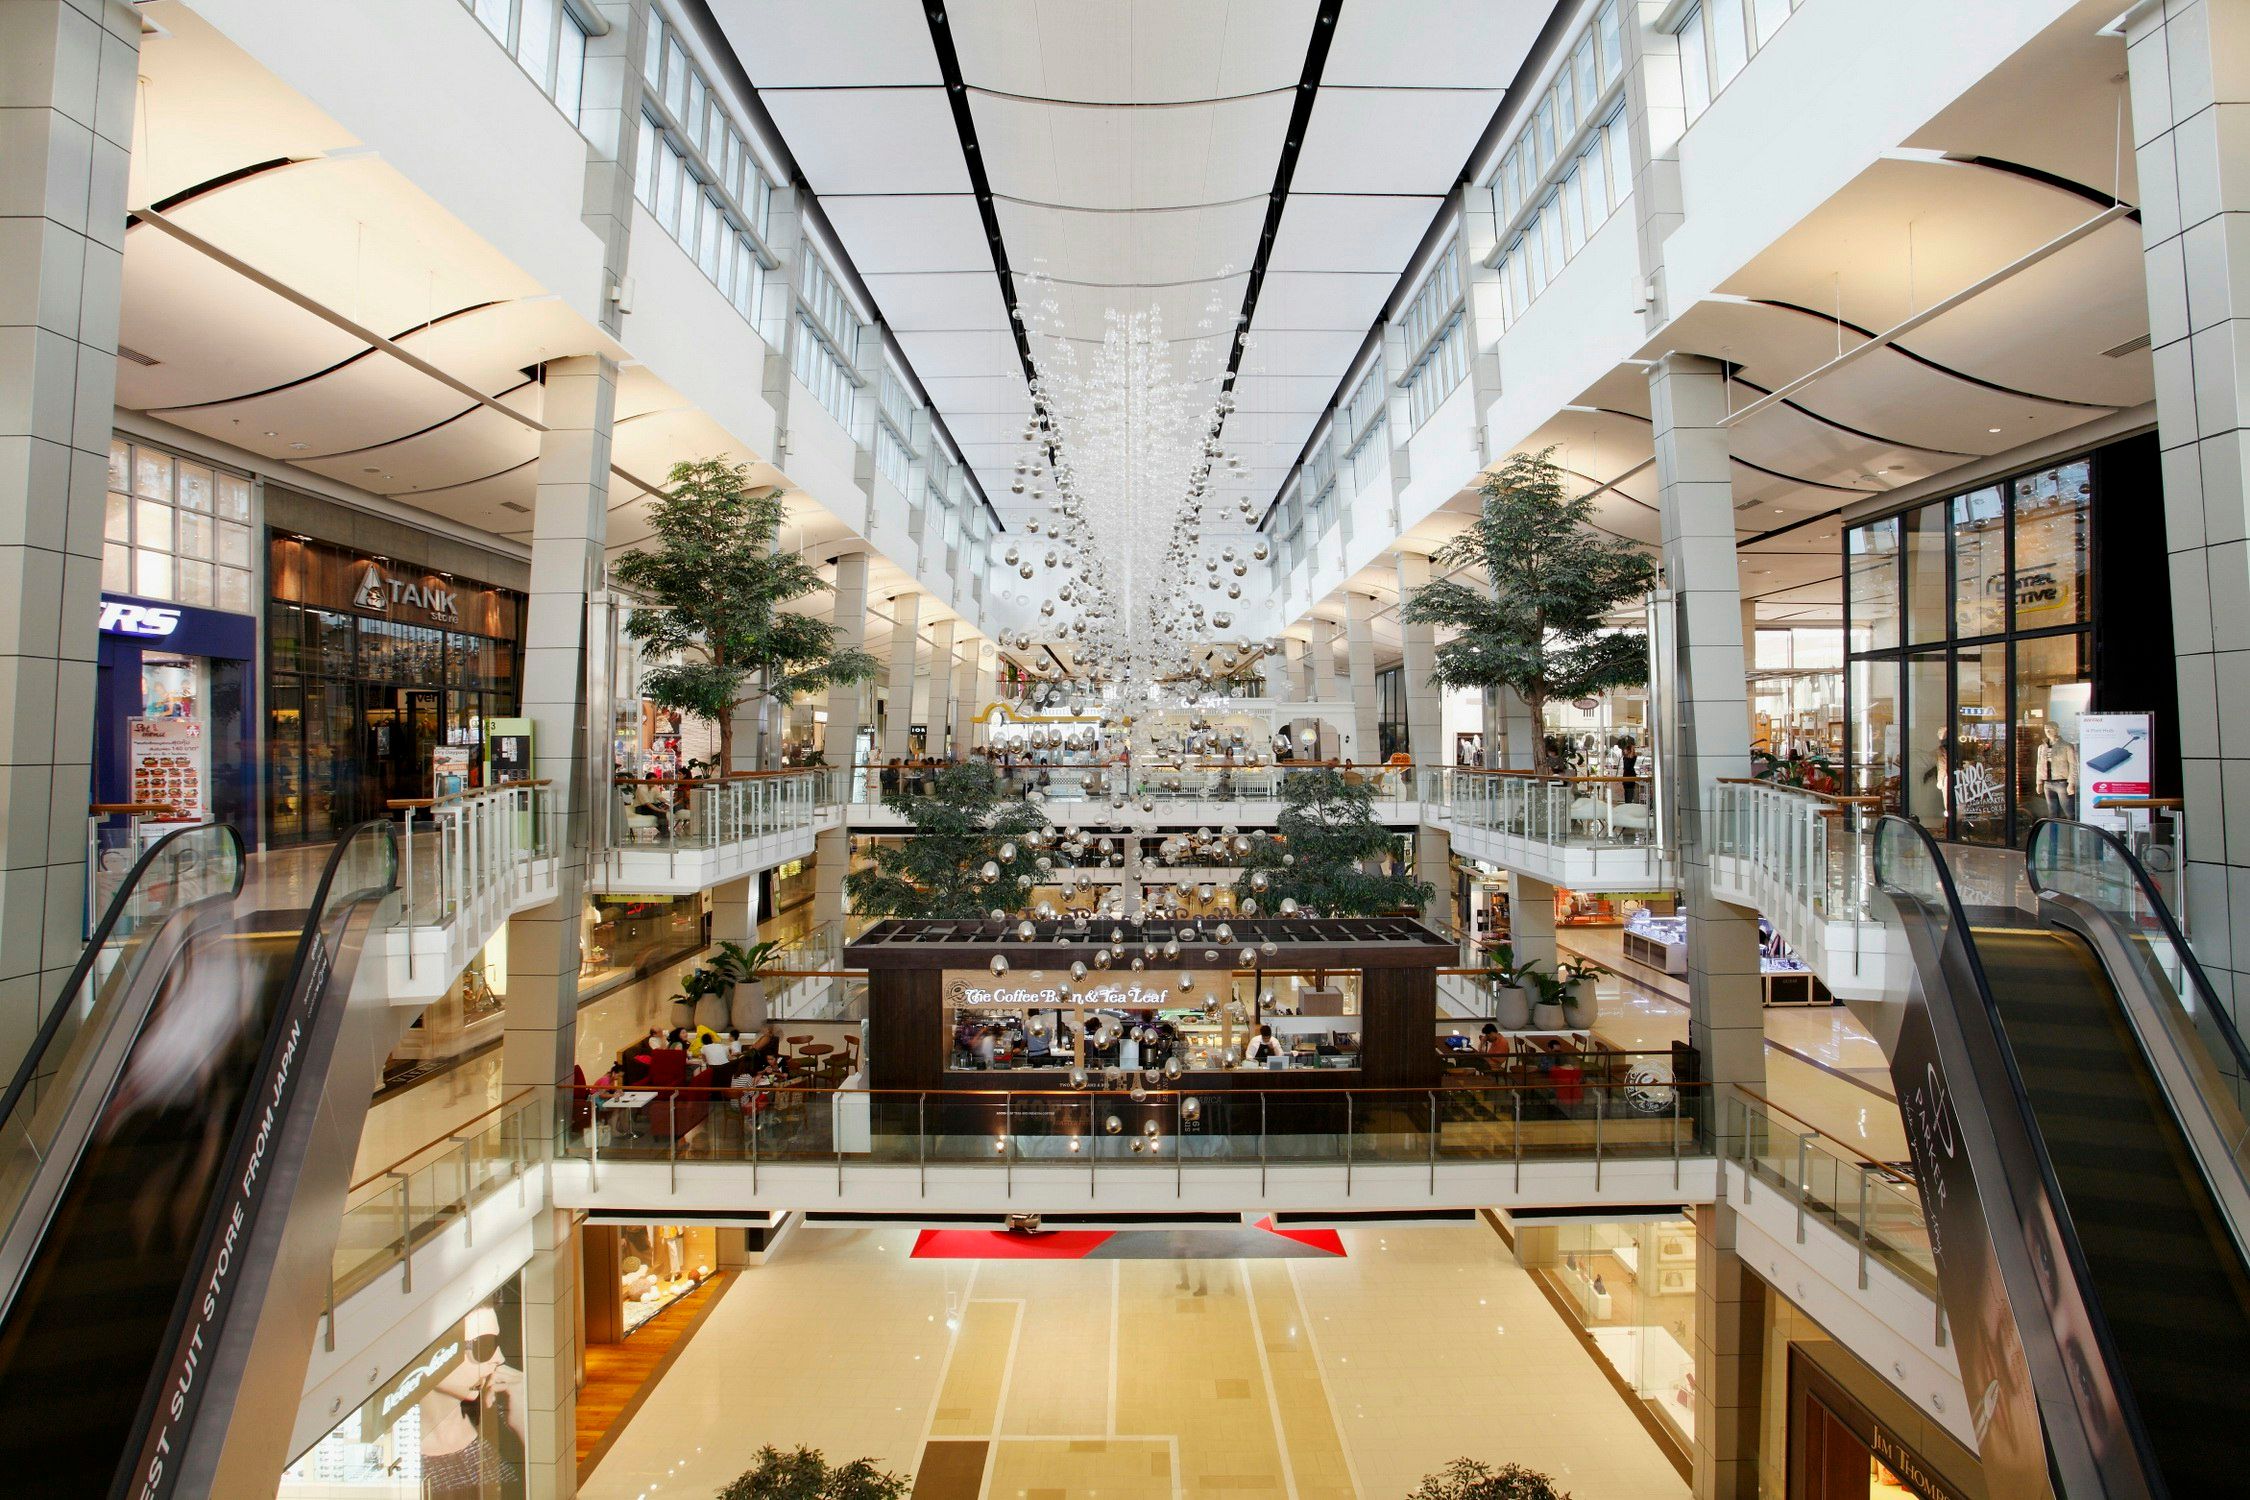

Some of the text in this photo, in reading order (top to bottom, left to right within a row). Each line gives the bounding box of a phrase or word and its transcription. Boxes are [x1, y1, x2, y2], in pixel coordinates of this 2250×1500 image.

[385, 578, 458, 615] TANK
[99, 602, 181, 635] RS
[431, 611, 459, 624] store
[490, 721, 496, 731] 3
[965, 989, 991, 1004] The
[993, 989, 1039, 1002] Coffee
[1040, 990, 1084, 1005] Bn
[1085, 990, 1098, 1002] &
[1102, 989, 1127, 1003] Tea
[1127, 989, 1169, 1003] Leaf
[1916, 1087, 1947, 1209] PARKER
[140, 1019, 301, 1500] EST SUIT STORE FROM JAPAN
[1871, 1425, 1951, 1500] JIM THOMP
